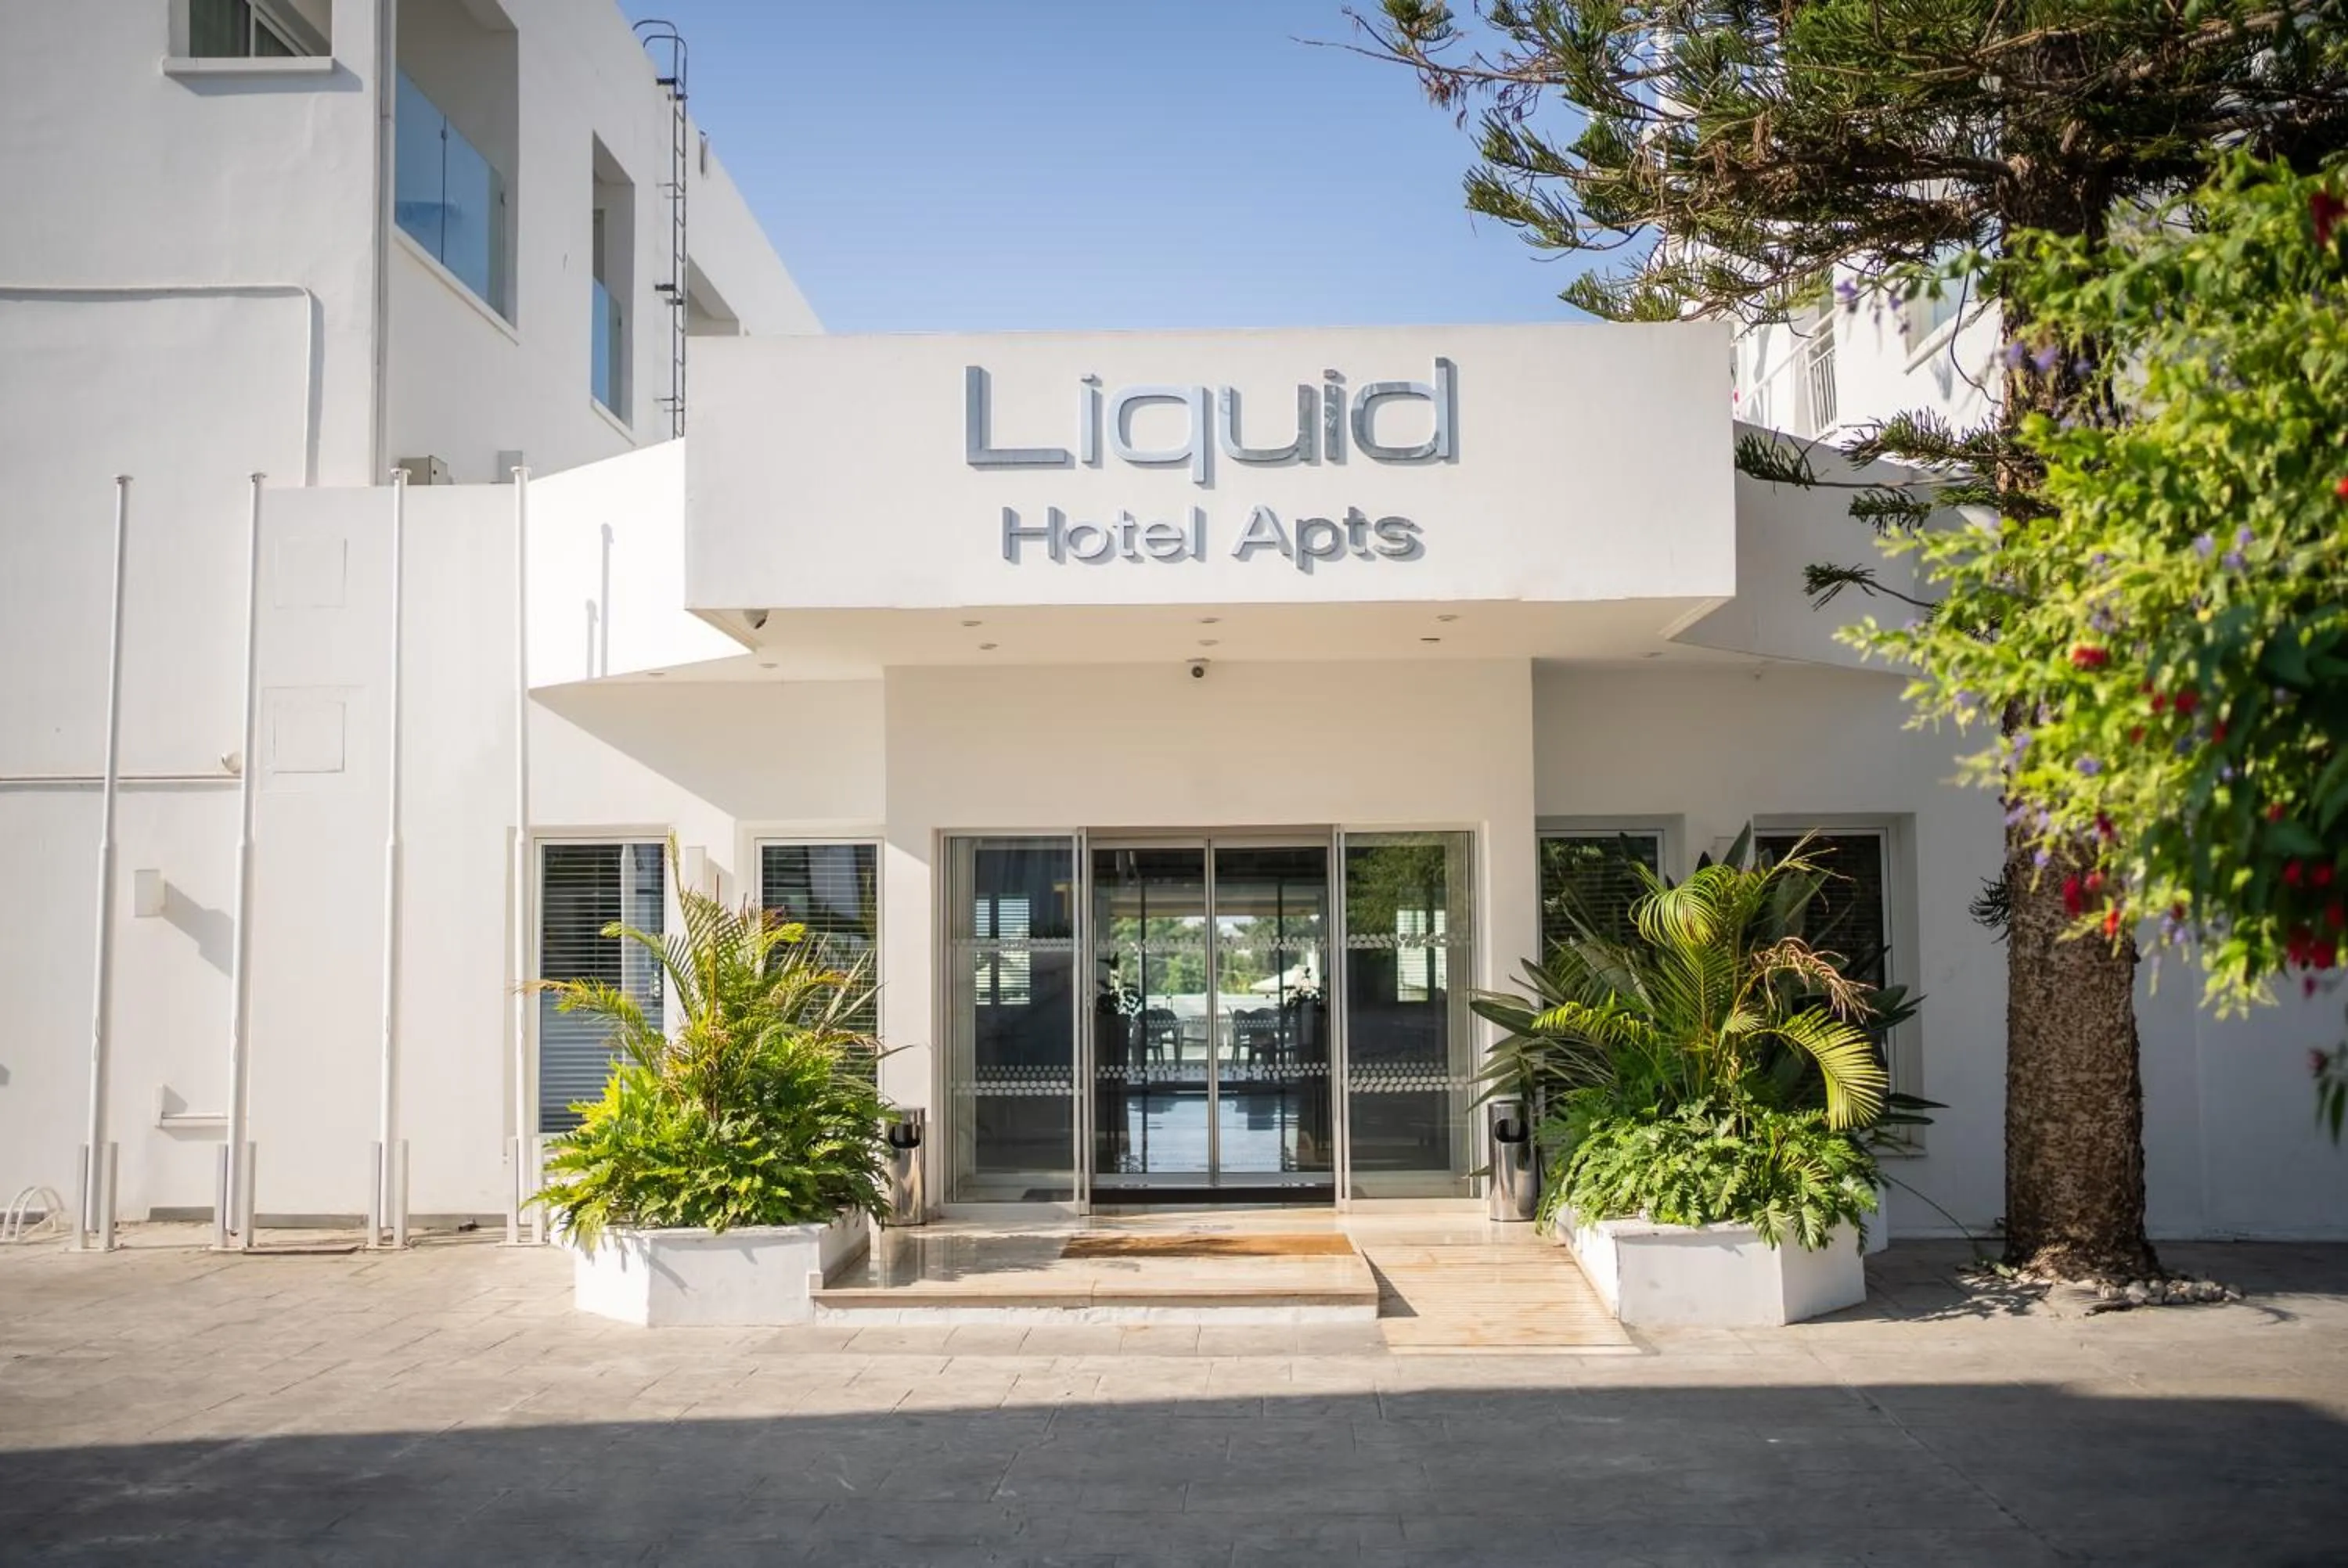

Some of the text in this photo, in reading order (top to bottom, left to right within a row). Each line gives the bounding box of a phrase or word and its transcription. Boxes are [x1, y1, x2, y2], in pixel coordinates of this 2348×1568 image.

[965, 357, 1457, 487] Liquid
[1002, 505, 1424, 574] Hotel Apts
